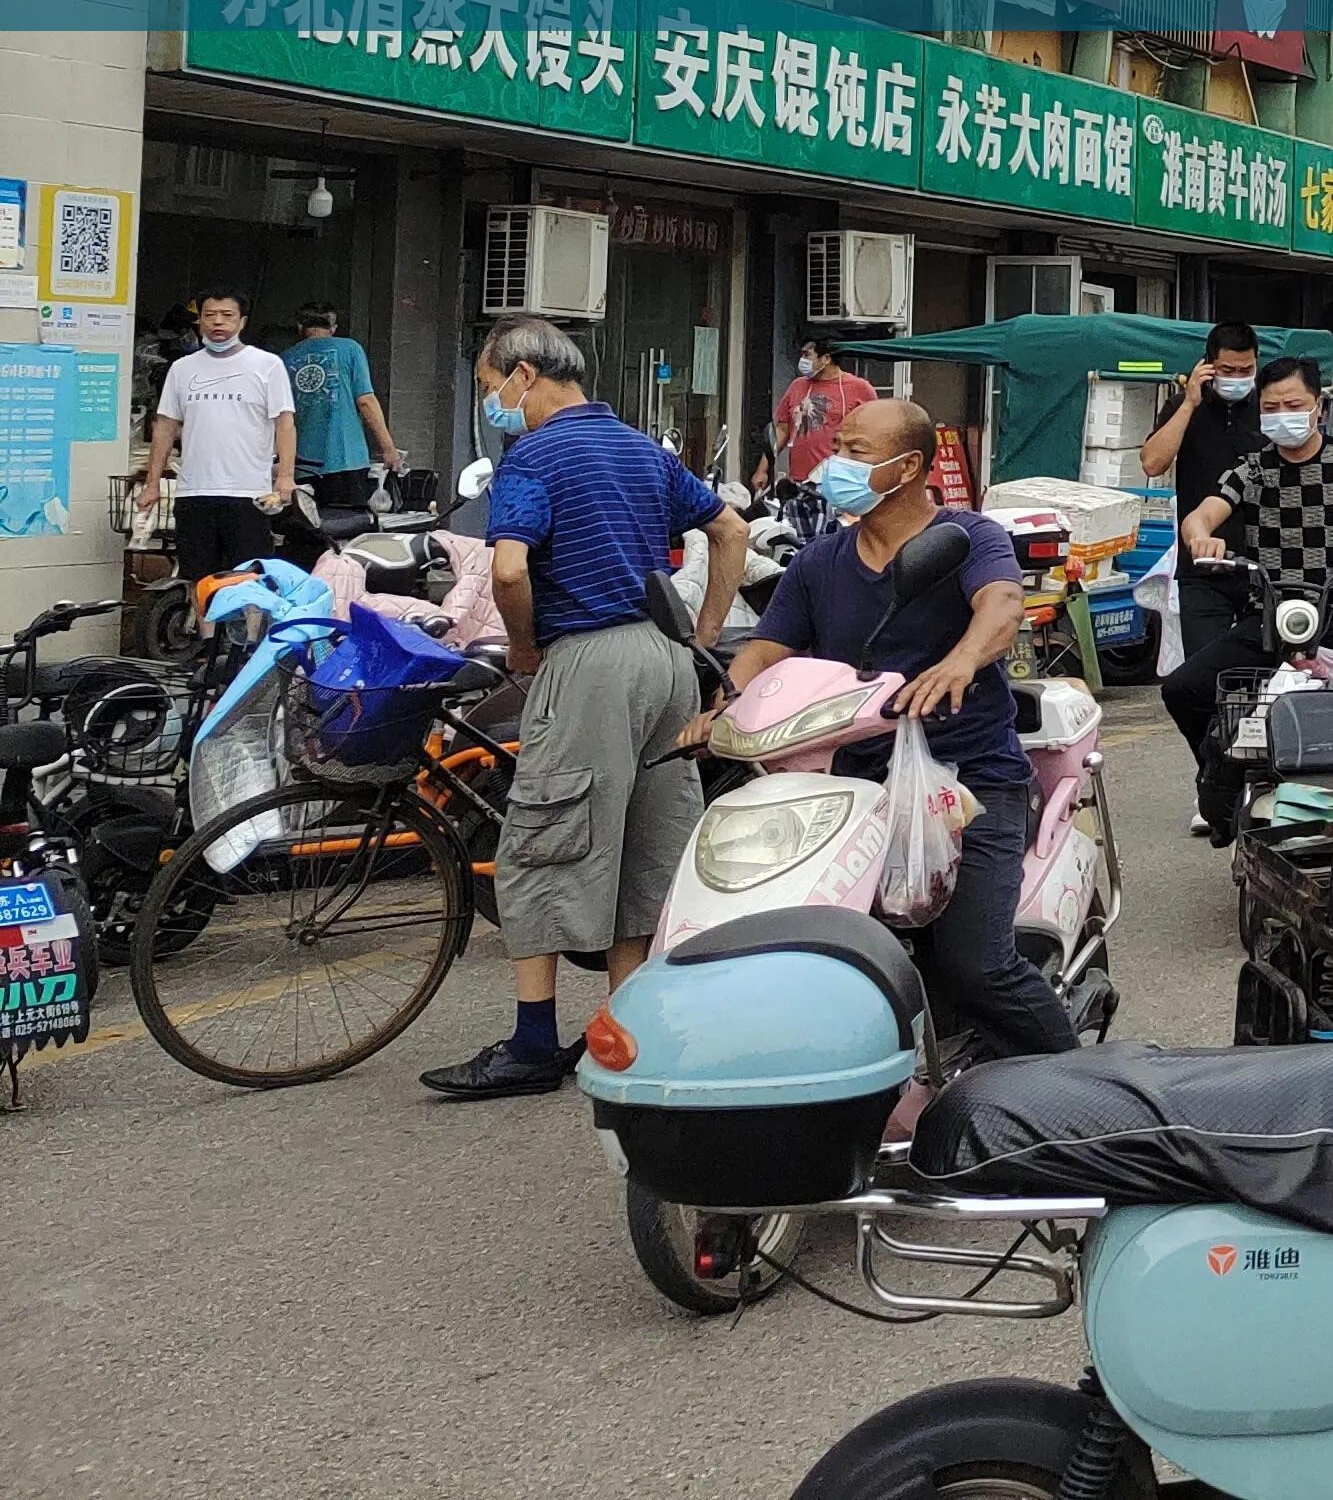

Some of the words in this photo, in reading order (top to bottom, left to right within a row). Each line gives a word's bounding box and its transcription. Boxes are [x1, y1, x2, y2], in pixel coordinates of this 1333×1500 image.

[654, 8, 918, 157] 安庆馄饨店
[935, 74, 1134, 197] 永芳大肉面馆
[1160, 130, 1288, 229] 淮南黄牛肉汤
[187, 392, 243, 402] RUNNING
[1243, 1247, 1300, 1271] 雅迪
